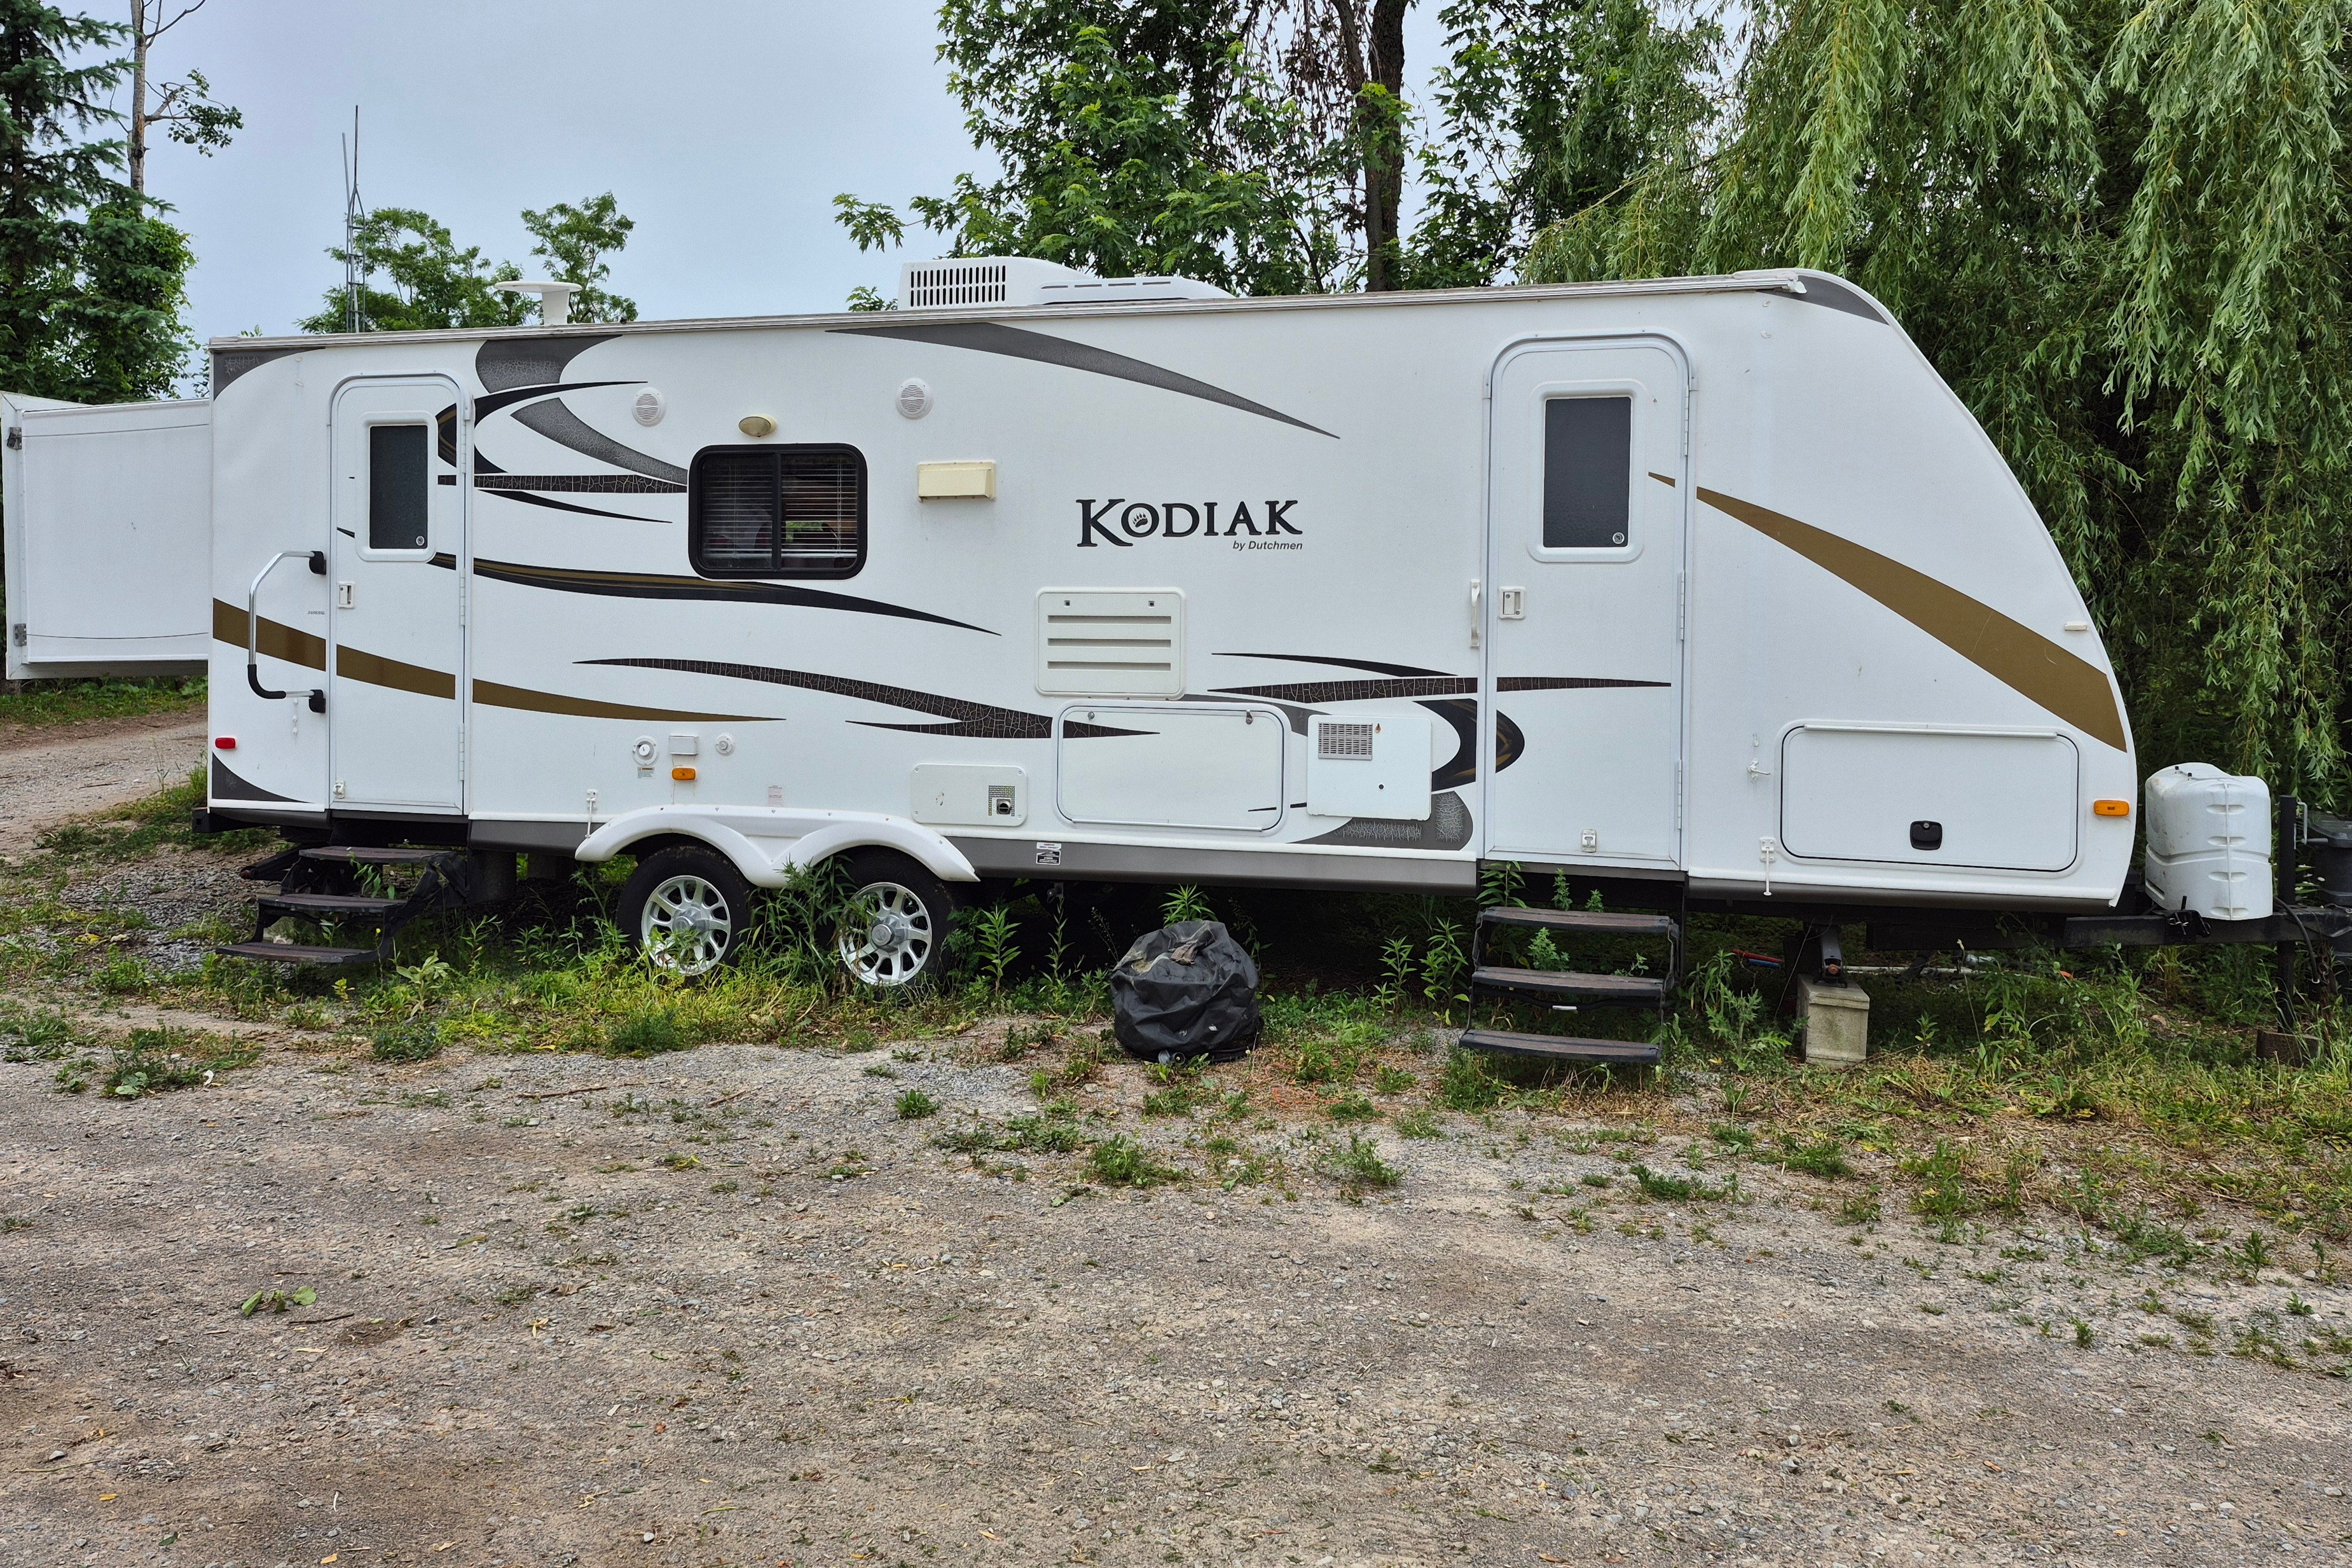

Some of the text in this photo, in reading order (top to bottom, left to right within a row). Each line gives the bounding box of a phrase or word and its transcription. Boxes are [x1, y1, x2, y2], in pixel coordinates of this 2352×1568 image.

[1075, 498, 1303, 547] KODIAK
[1232, 540, 1303, 551] by Dutchmen
